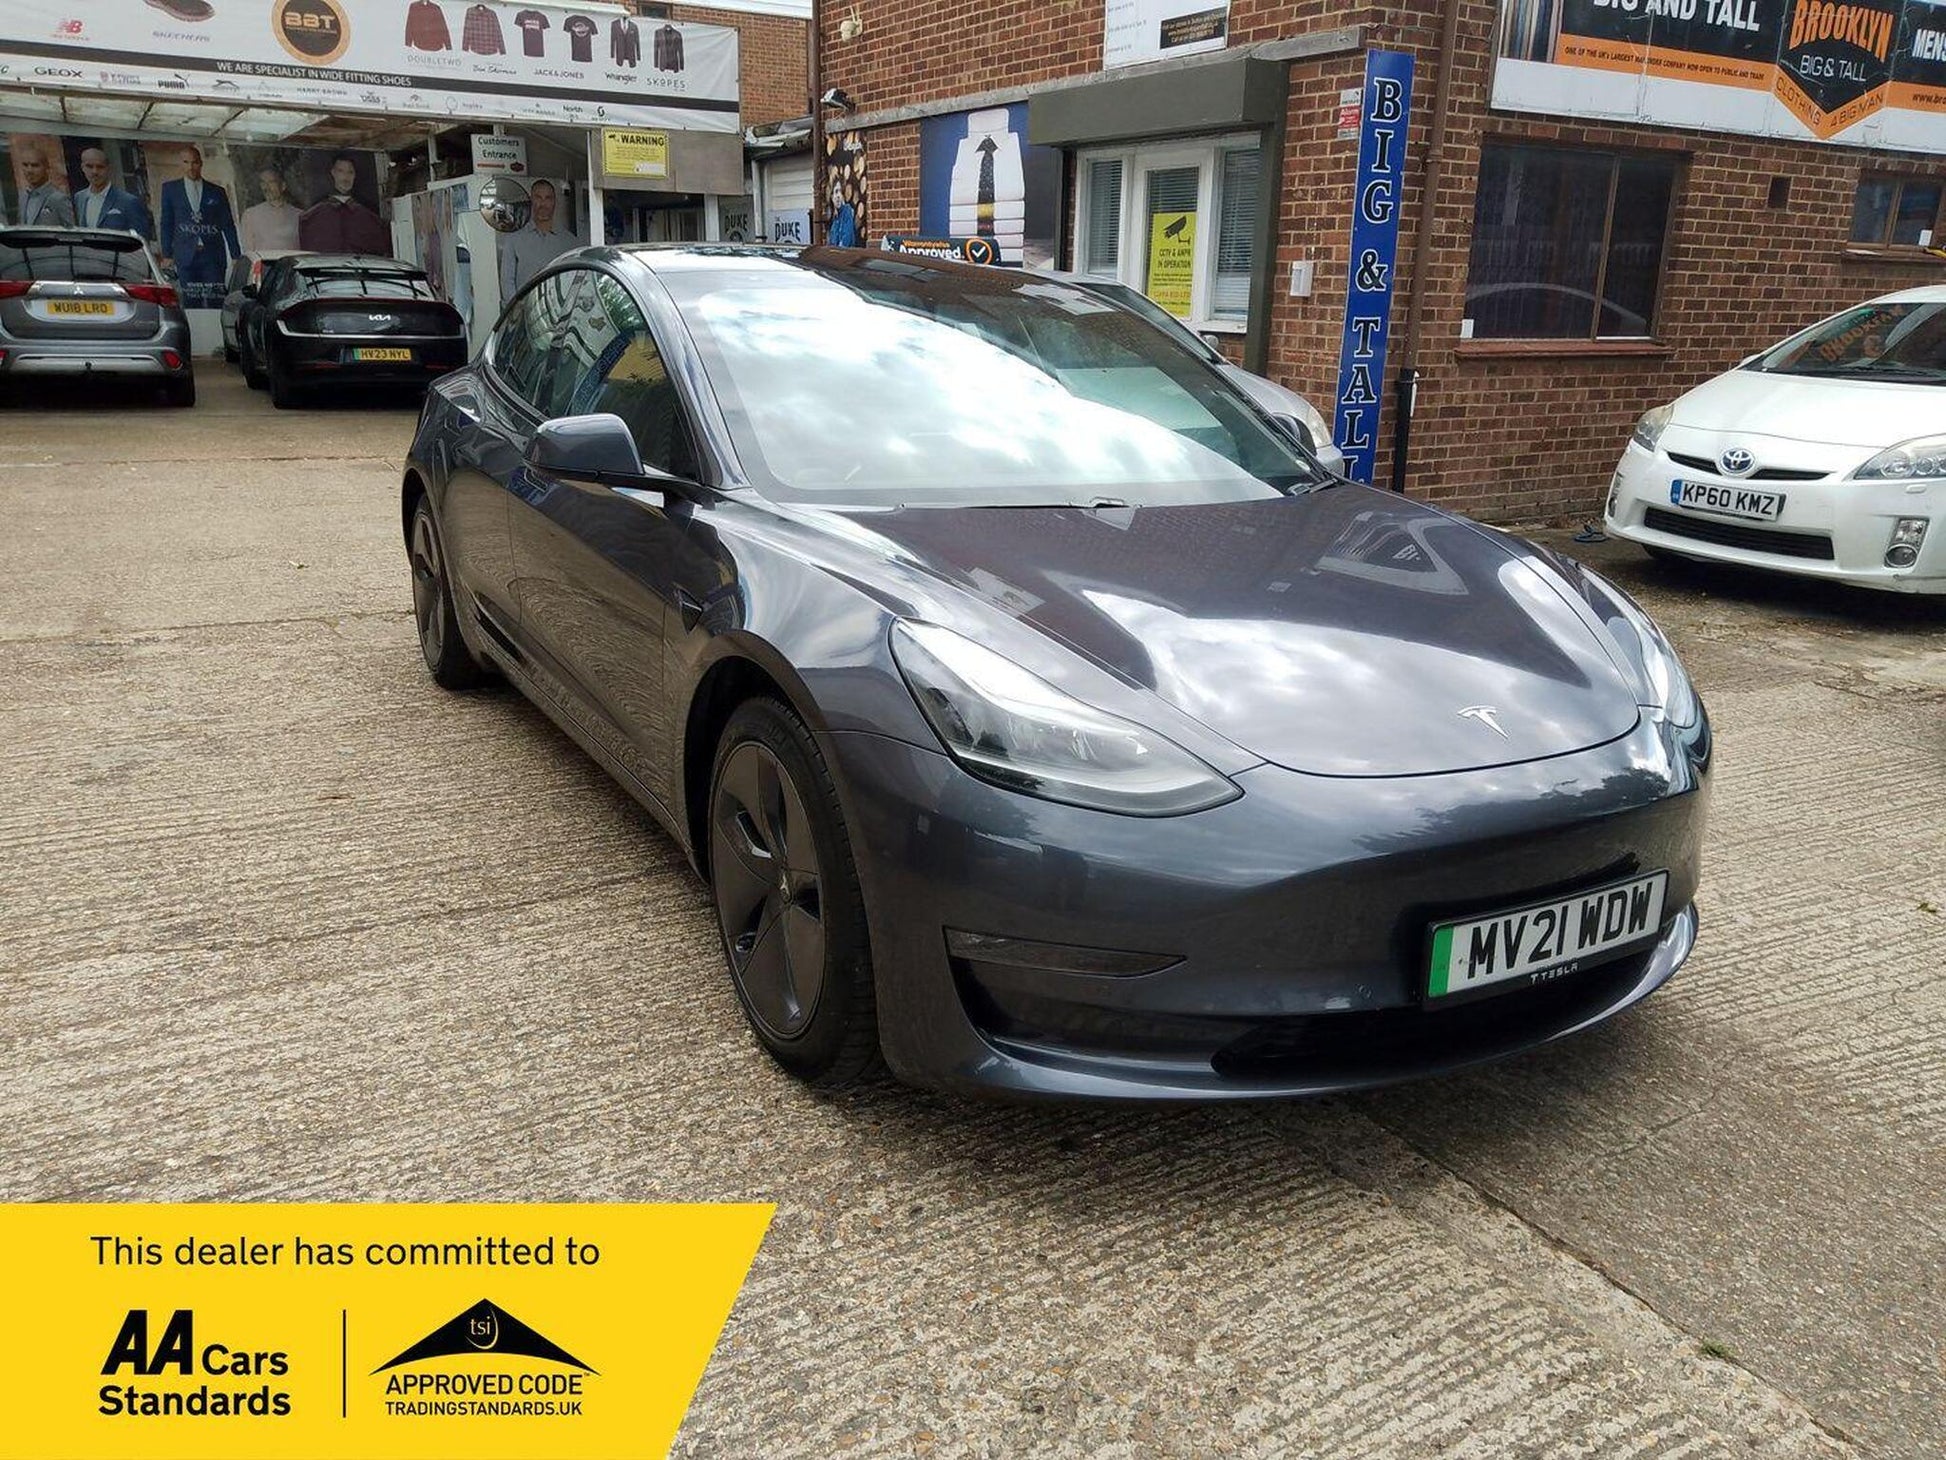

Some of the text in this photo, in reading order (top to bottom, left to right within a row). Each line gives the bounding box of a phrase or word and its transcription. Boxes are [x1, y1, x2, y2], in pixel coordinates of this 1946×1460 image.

[285, 11, 335, 29] BBT
[1705, 0, 1760, 31] TALL
[1789, 0, 1893, 64] BROOKLYN
[34, 67, 83, 79] GEOX
[217, 62, 412, 87] WE ARE SPECIALIST IN WIDE FITTING SHOES
[1839, 60, 1867, 82] TALL
[647, 77, 686, 89] SKOPES
[1776, 76, 1822, 126] CLOTHING
[478, 136, 519, 147] Customers
[621, 134, 665, 147] WARNING
[1361, 77, 1403, 224] BIG
[482, 150, 517, 160] Entrance
[725, 214, 748, 234] DUKE
[775, 222, 801, 243] DUKE
[1355, 248, 1388, 293] &
[1682, 483, 1775, 515] KP60 KMZ
[1467, 881, 1653, 980] MV21 WDW
[1541, 962, 1578, 981] TESLA
